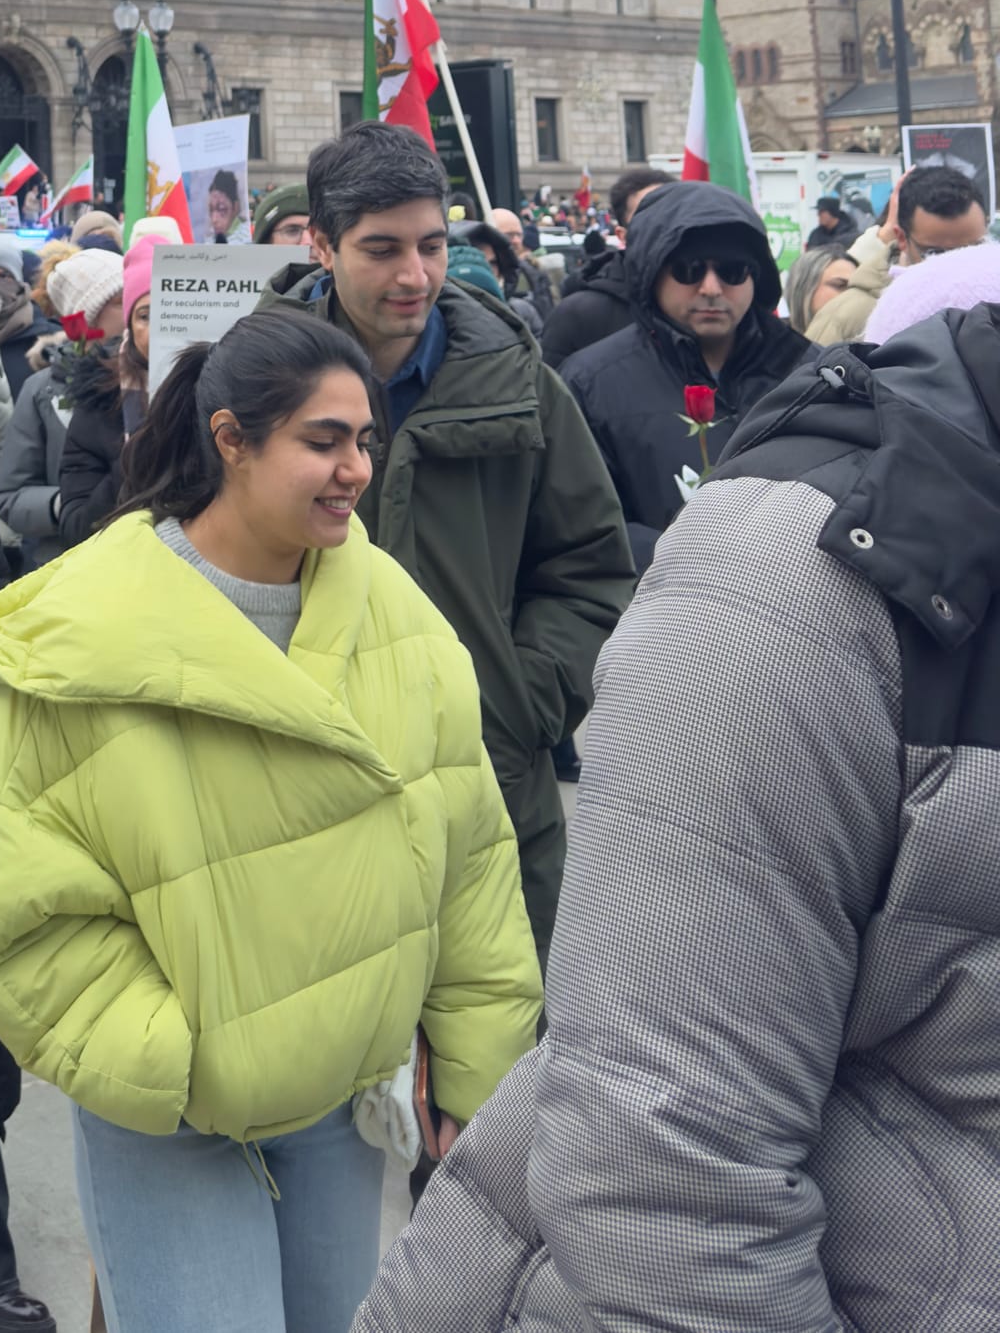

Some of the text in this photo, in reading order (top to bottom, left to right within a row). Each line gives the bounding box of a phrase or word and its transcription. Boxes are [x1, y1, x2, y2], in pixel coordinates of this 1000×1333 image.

[161, 279, 262, 293] REZA PAHL
[161, 299, 240, 308] for secularism and
[160, 312, 209, 322] democracy
[160, 325, 188, 333] in Iran
